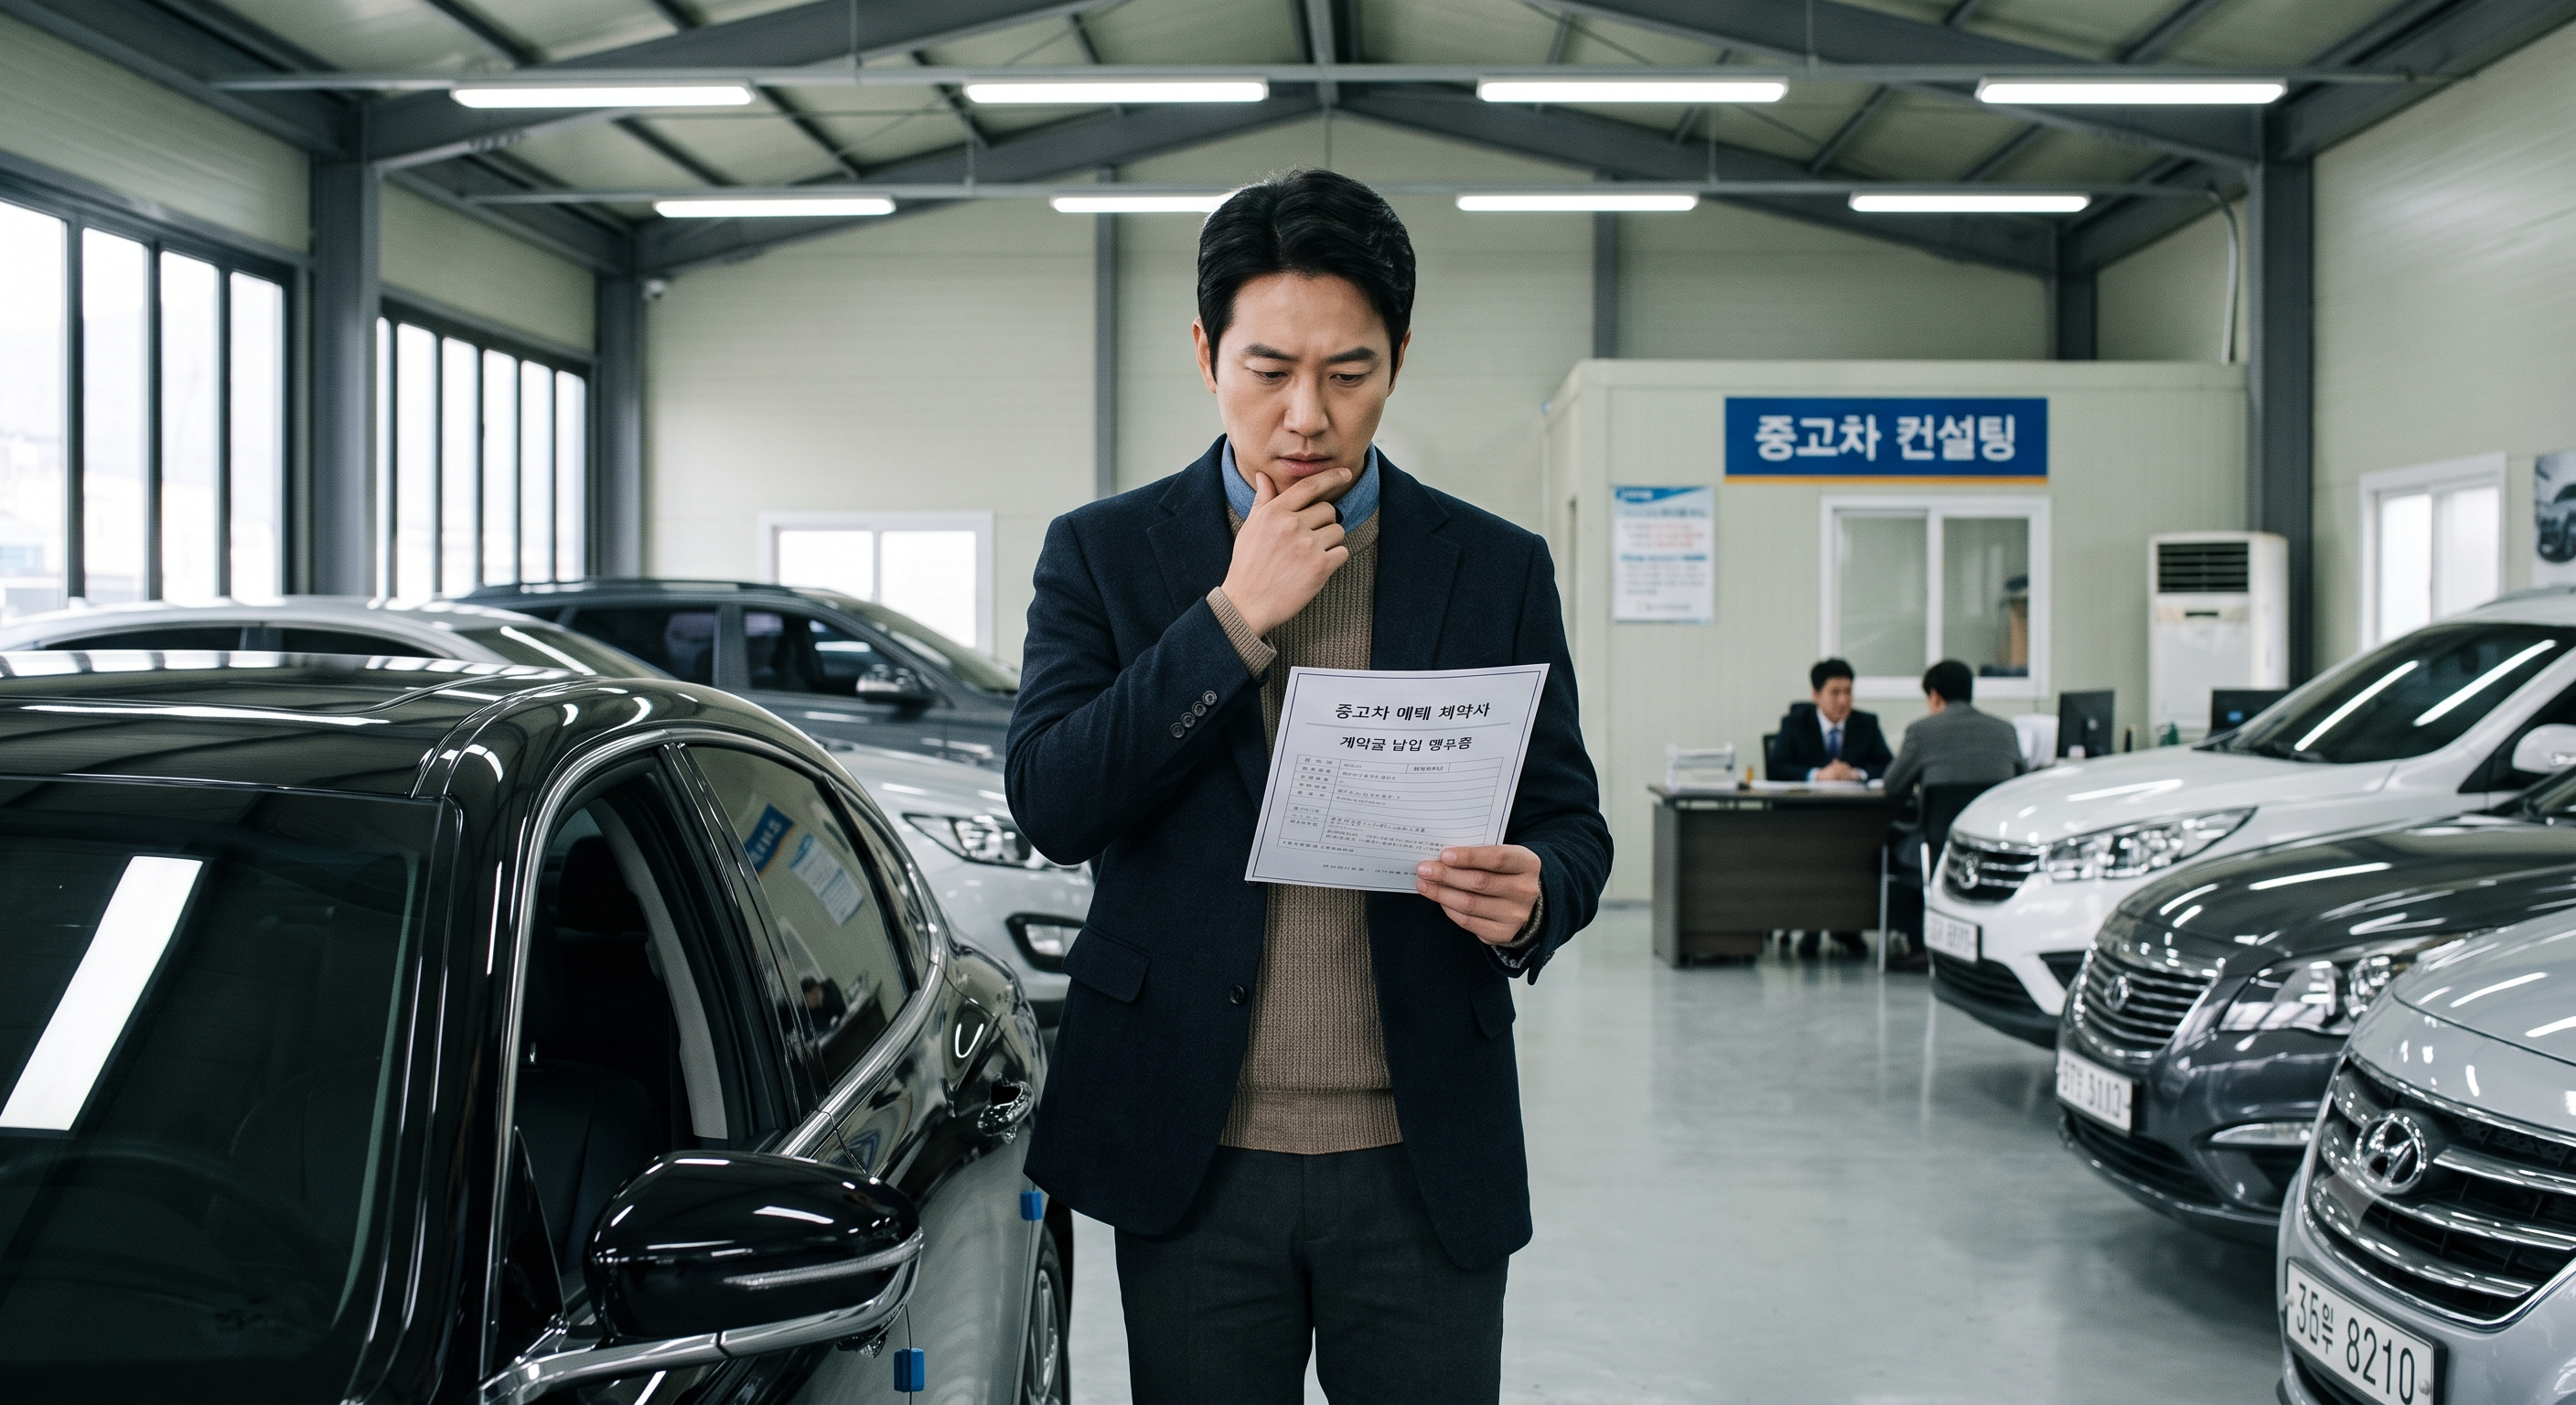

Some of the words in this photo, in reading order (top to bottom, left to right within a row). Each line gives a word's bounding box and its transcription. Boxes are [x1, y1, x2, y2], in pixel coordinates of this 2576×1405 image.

[1755, 414, 1882, 461] 중고차
[1895, 414, 2016, 461] 컨설팅
[1335, 703, 1390, 720] 중고차
[2345, 1316, 2416, 1405] 8210
